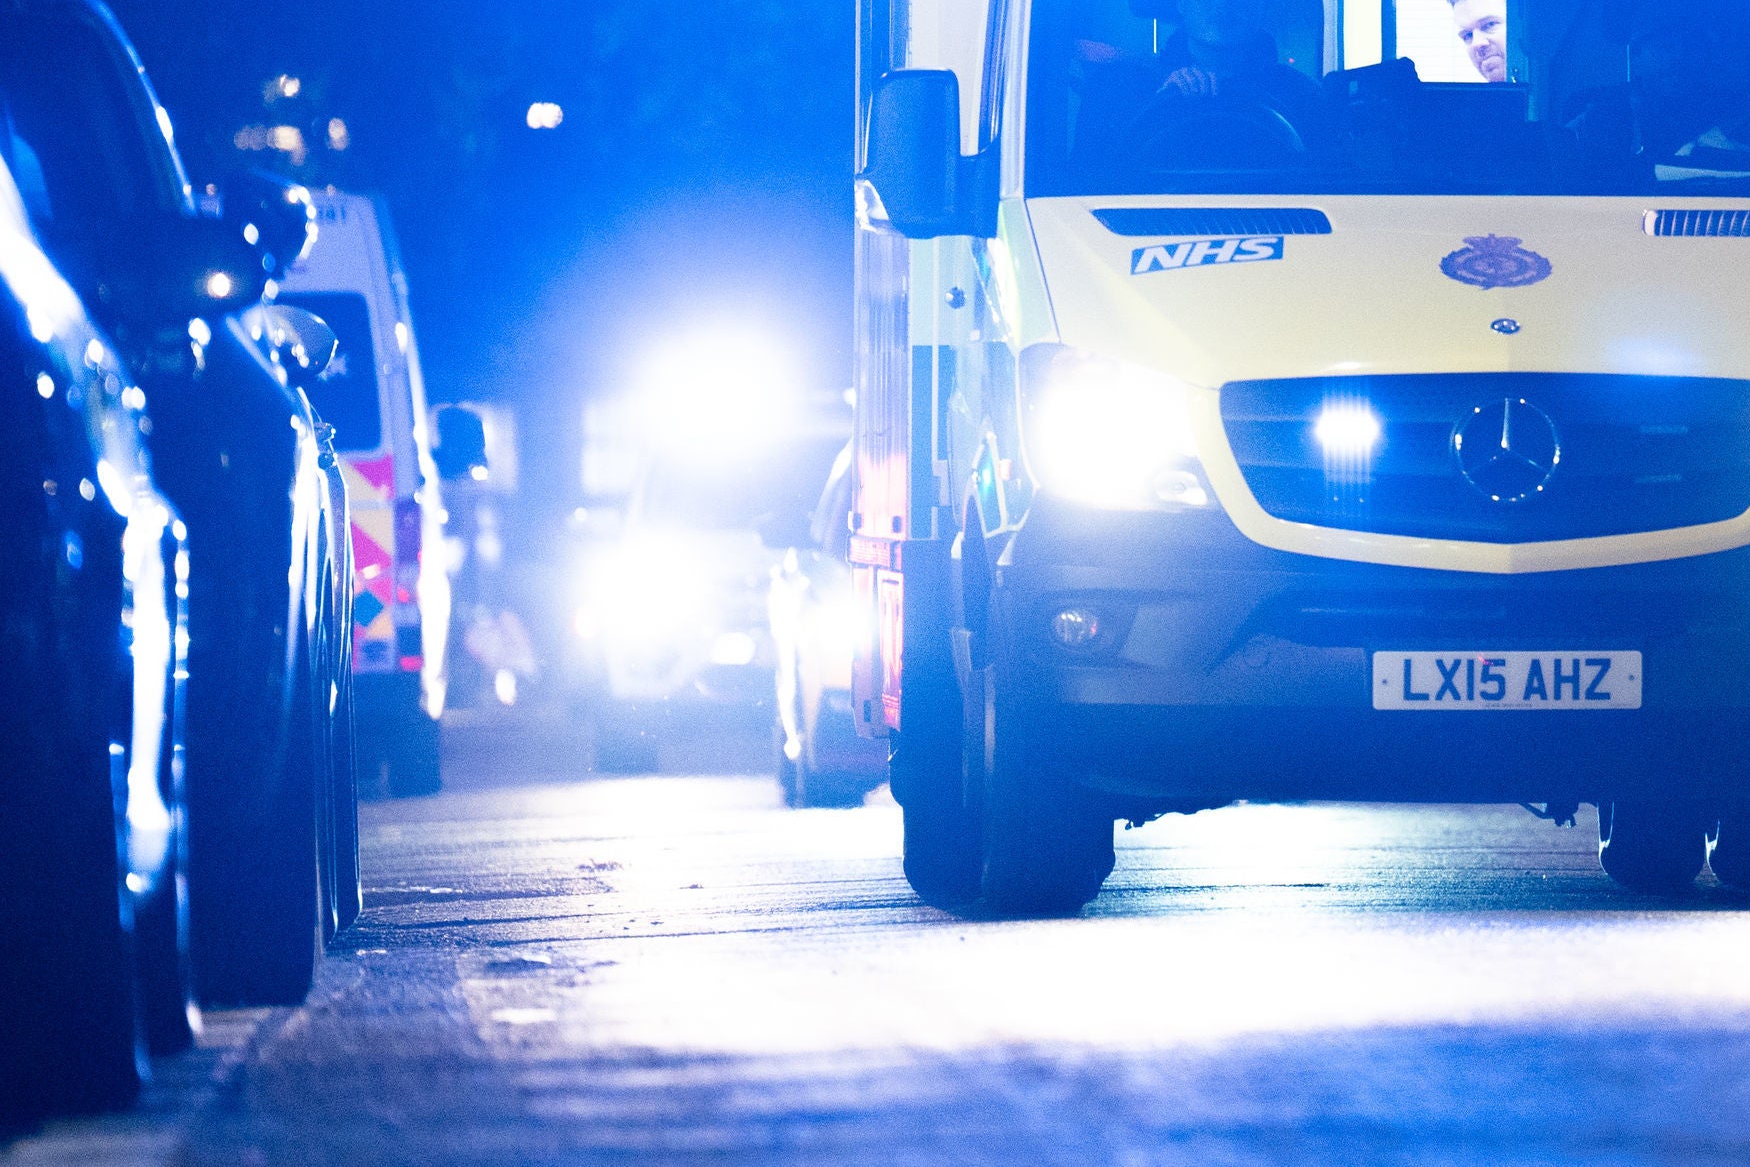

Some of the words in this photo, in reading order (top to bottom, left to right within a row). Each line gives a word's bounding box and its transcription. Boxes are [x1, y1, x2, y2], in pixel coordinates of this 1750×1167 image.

[1133, 236, 1279, 274] NHS
[1402, 658, 1506, 701] LX15
[1522, 658, 1612, 701] AHZ
